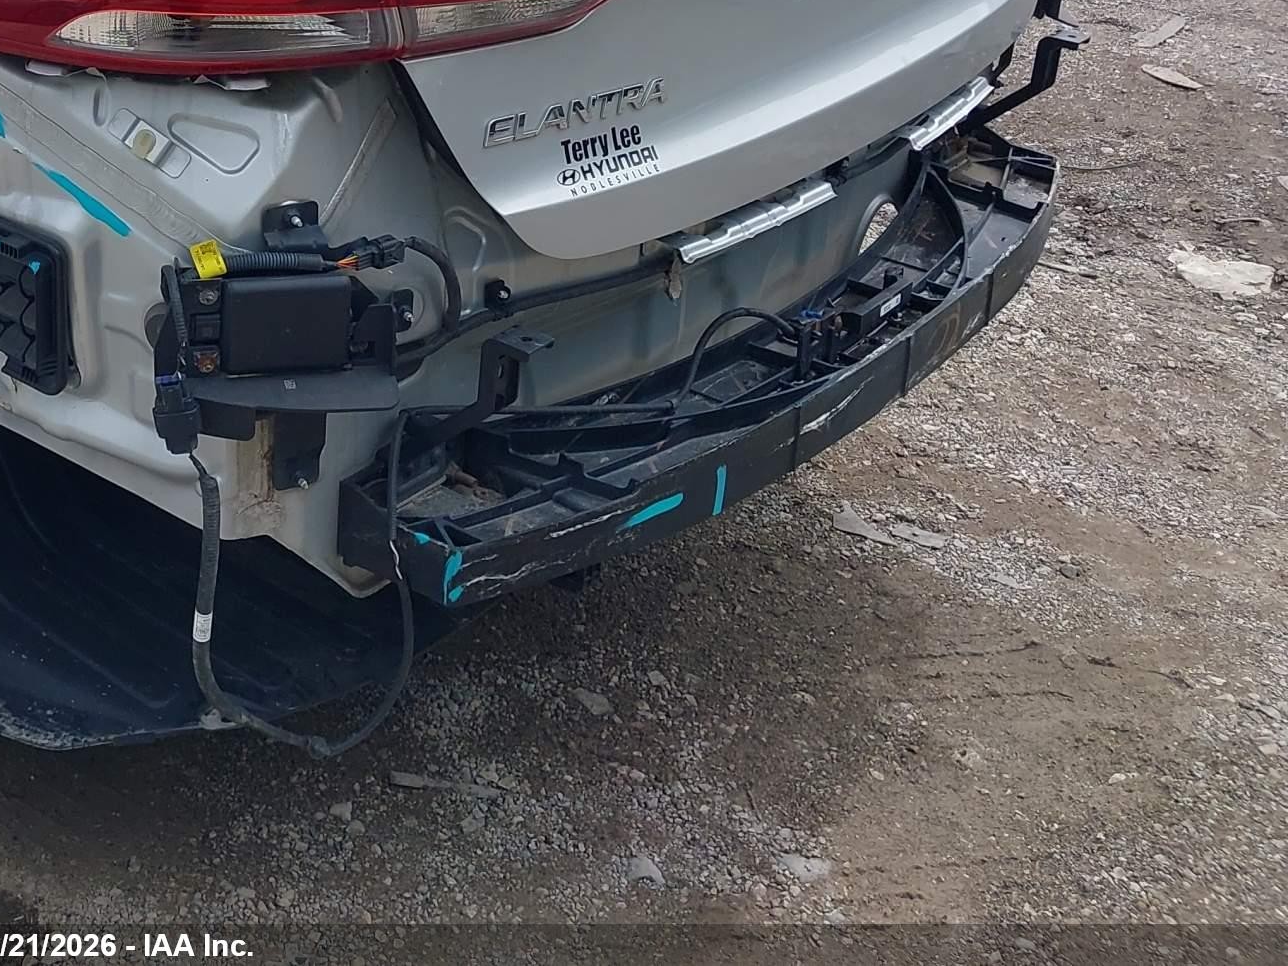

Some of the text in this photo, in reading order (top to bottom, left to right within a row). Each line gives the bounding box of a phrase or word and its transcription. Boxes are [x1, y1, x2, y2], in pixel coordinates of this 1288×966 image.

[483, 76, 667, 148] ELANTRA
[561, 124, 642, 165] Terry Lee
[580, 145, 659, 181] HYUNDAI
